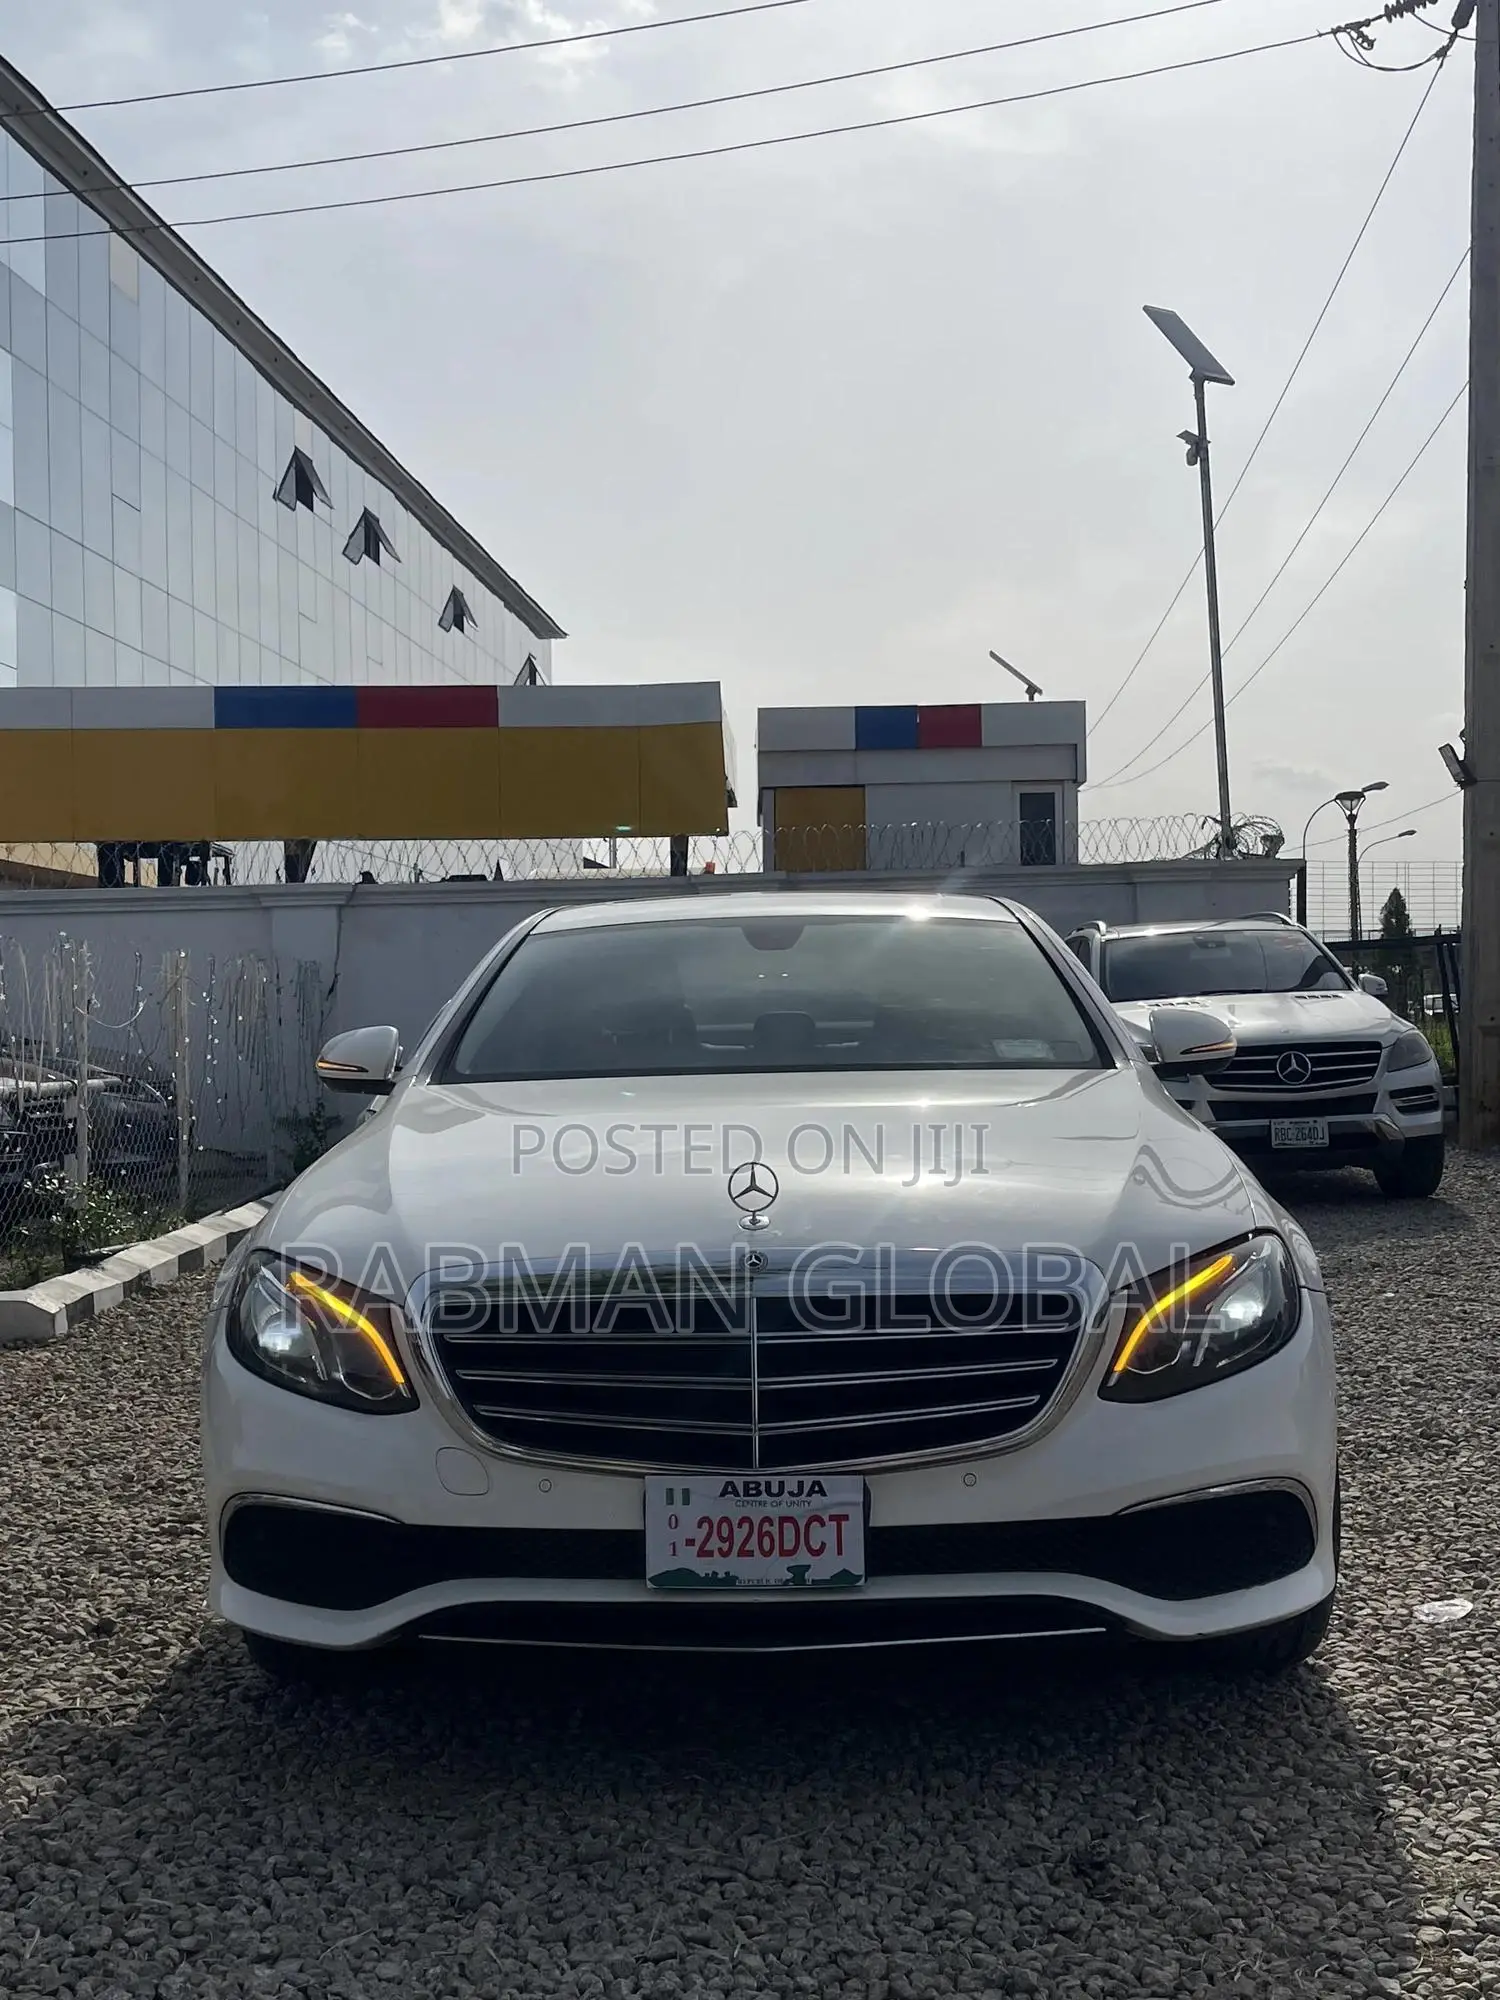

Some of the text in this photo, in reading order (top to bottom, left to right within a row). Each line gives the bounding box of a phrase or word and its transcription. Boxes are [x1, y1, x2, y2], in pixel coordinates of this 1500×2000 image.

[719, 1479, 828, 1498] ABUJA
[734, 1499, 812, 1509] CENTRE OF UNITY
